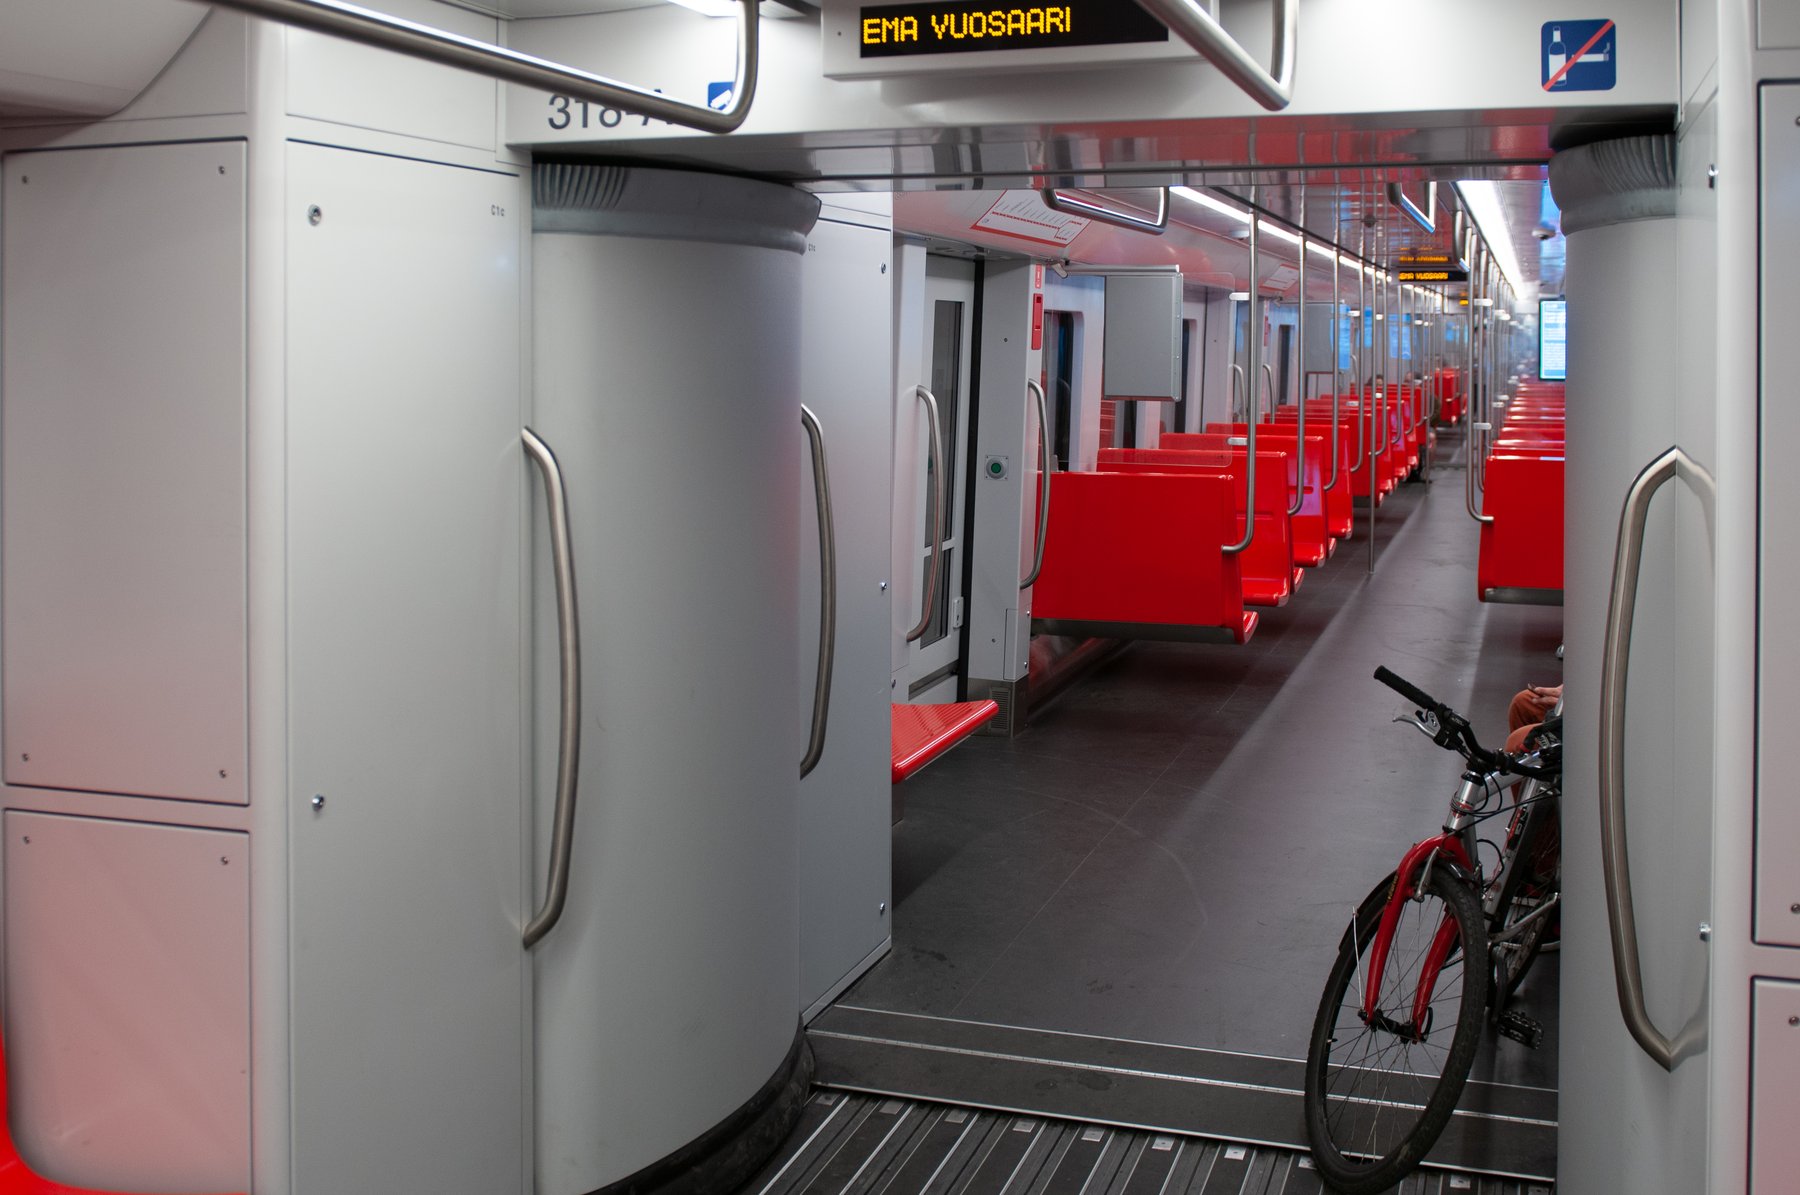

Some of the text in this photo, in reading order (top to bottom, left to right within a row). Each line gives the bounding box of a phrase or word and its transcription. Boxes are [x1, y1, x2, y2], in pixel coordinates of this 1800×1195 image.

[863, 7, 1070, 44] EMA VUOSAARI
[548, 89, 674, 130] 318-
